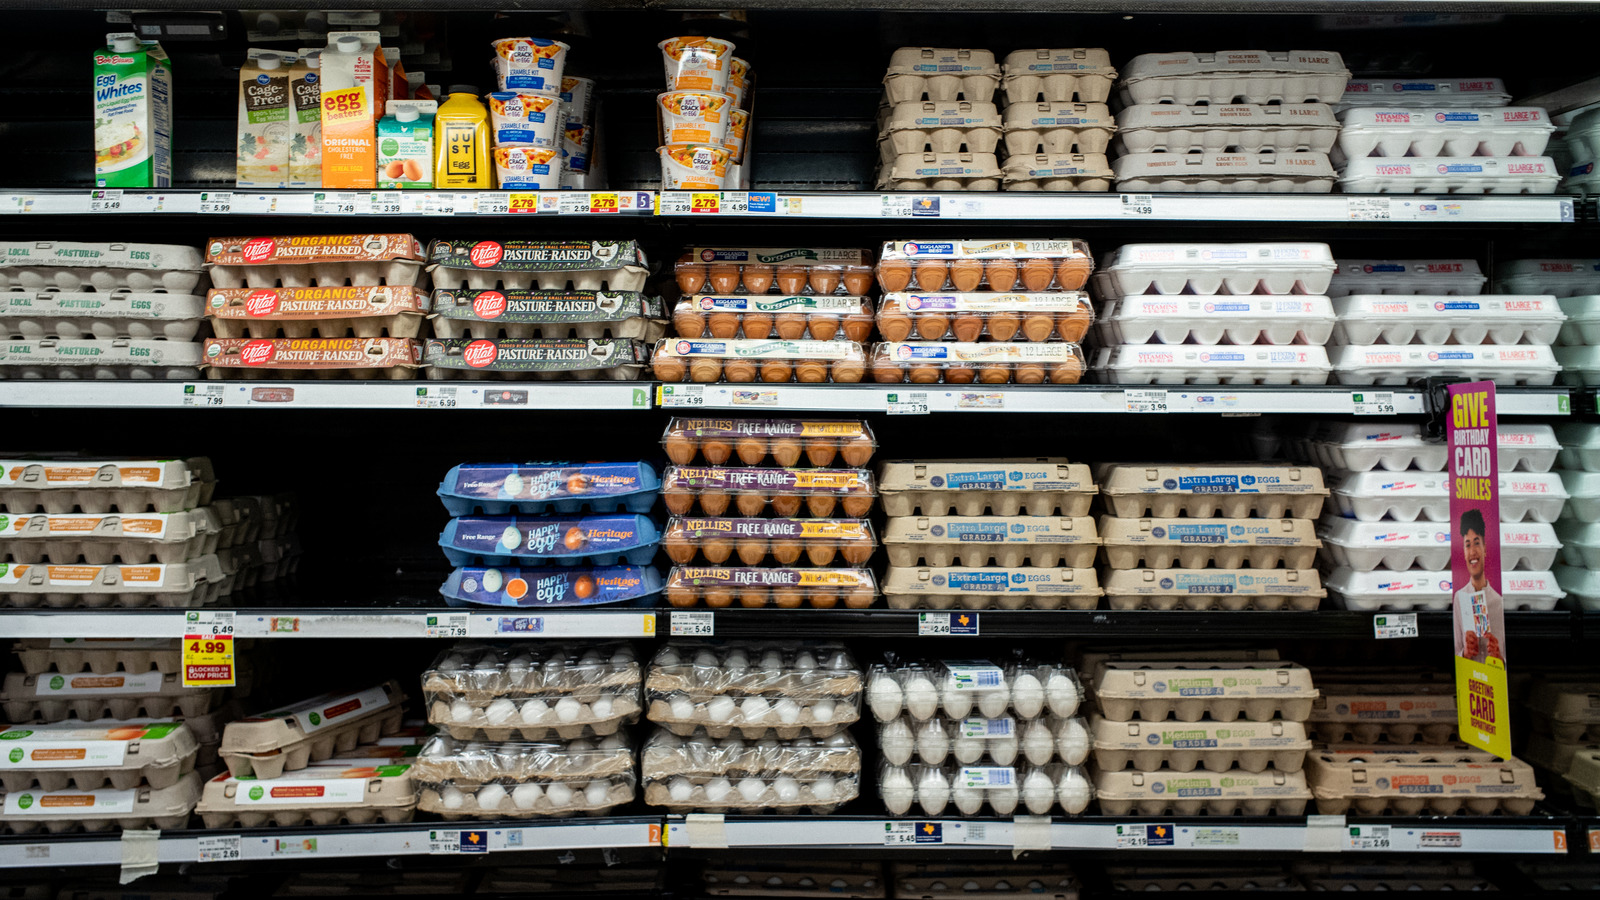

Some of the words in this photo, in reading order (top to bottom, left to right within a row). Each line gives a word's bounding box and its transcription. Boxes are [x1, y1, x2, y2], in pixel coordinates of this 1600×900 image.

[97, 75, 116, 86] Egg
[97, 82, 142, 101] Whites
[324, 92, 361, 111] egg
[327, 110, 363, 120] beaters
[594, 199, 614, 207] 2.79
[638, 193, 648, 208] 5
[695, 199, 715, 207] 2.79
[1564, 206, 1569, 218] 5
[292, 236, 352, 246] ORGANIC
[1032, 243, 1040, 251] 12
[1042, 242, 1068, 250] LARGE
[131, 251, 150, 259] EGGS
[244, 243, 272, 257] Vital
[276, 246, 361, 256] PASTURE-RAISED
[472, 247, 499, 261] Vital
[504, 250, 591, 260] PASTURE-RAISED
[823, 251, 831, 259] 12
[833, 251, 858, 259] LARGE
[761, 250, 807, 263] Organic
[295, 289, 356, 299] ORGANIC
[60, 300, 101, 308] PASTURED
[248, 295, 275, 310] Vital
[280, 300, 367, 311] PASTURE-RAISED
[475, 297, 503, 311] Vital
[507, 301, 596, 312] PASTURE-RAISED
[761, 298, 806, 310] Organic
[291, 340, 352, 350] ORGANIC
[59, 347, 100, 355] PASTURED
[130, 348, 150, 356] EGGS
[243, 345, 270, 359] Vital
[275, 351, 362, 360] PASTURE-RAISED
[465, 346, 493, 360] Vital
[498, 349, 587, 360] PASTURE-RAISED
[636, 392, 642, 403] 4
[1453, 391, 1489, 428] GIVE
[1561, 400, 1567, 411] 4
[738, 423, 760, 434] FREE
[765, 423, 796, 433] RANGE
[1454, 429, 1489, 446] BIRTHDAY
[1455, 447, 1490, 476] CARD
[531, 470, 562, 486] HAPPY
[591, 475, 635, 484] Heritage
[730, 473, 753, 484] FREE
[757, 473, 789, 484] RANGE
[949, 473, 973, 482] Extra
[977, 473, 1004, 482] Large
[1182, 476, 1206, 484] Extra
[1210, 476, 1236, 484] Large
[530, 480, 560, 497] egg
[1456, 479, 1491, 500] SMILES
[529, 523, 560, 538] HAPPY
[588, 529, 632, 538] Heritage
[737, 524, 759, 534] FREE
[764, 524, 795, 534] RANGE
[950, 524, 974, 532] Extra
[978, 524, 1005, 533] Large
[528, 535, 558, 553] egg
[537, 573, 568, 588] HAPPY
[596, 577, 640, 586] Heritage
[735, 572, 757, 583] FREE
[762, 572, 793, 583] RANGE
[951, 574, 974, 582] Extra
[979, 574, 1006, 583] Large
[537, 584, 567, 603] egg
[212, 626, 233, 634] 6.49
[647, 619, 652, 631] 3
[190, 642, 225, 653] 4.99
[1171, 679, 1210, 687] Medium
[1469, 679, 1494, 699] GREETING
[1470, 693, 1495, 723] CARD
[1471, 718, 1496, 735] DEPARTMENT
[652, 830, 657, 841] 2
[1557, 836, 1563, 847] 2
